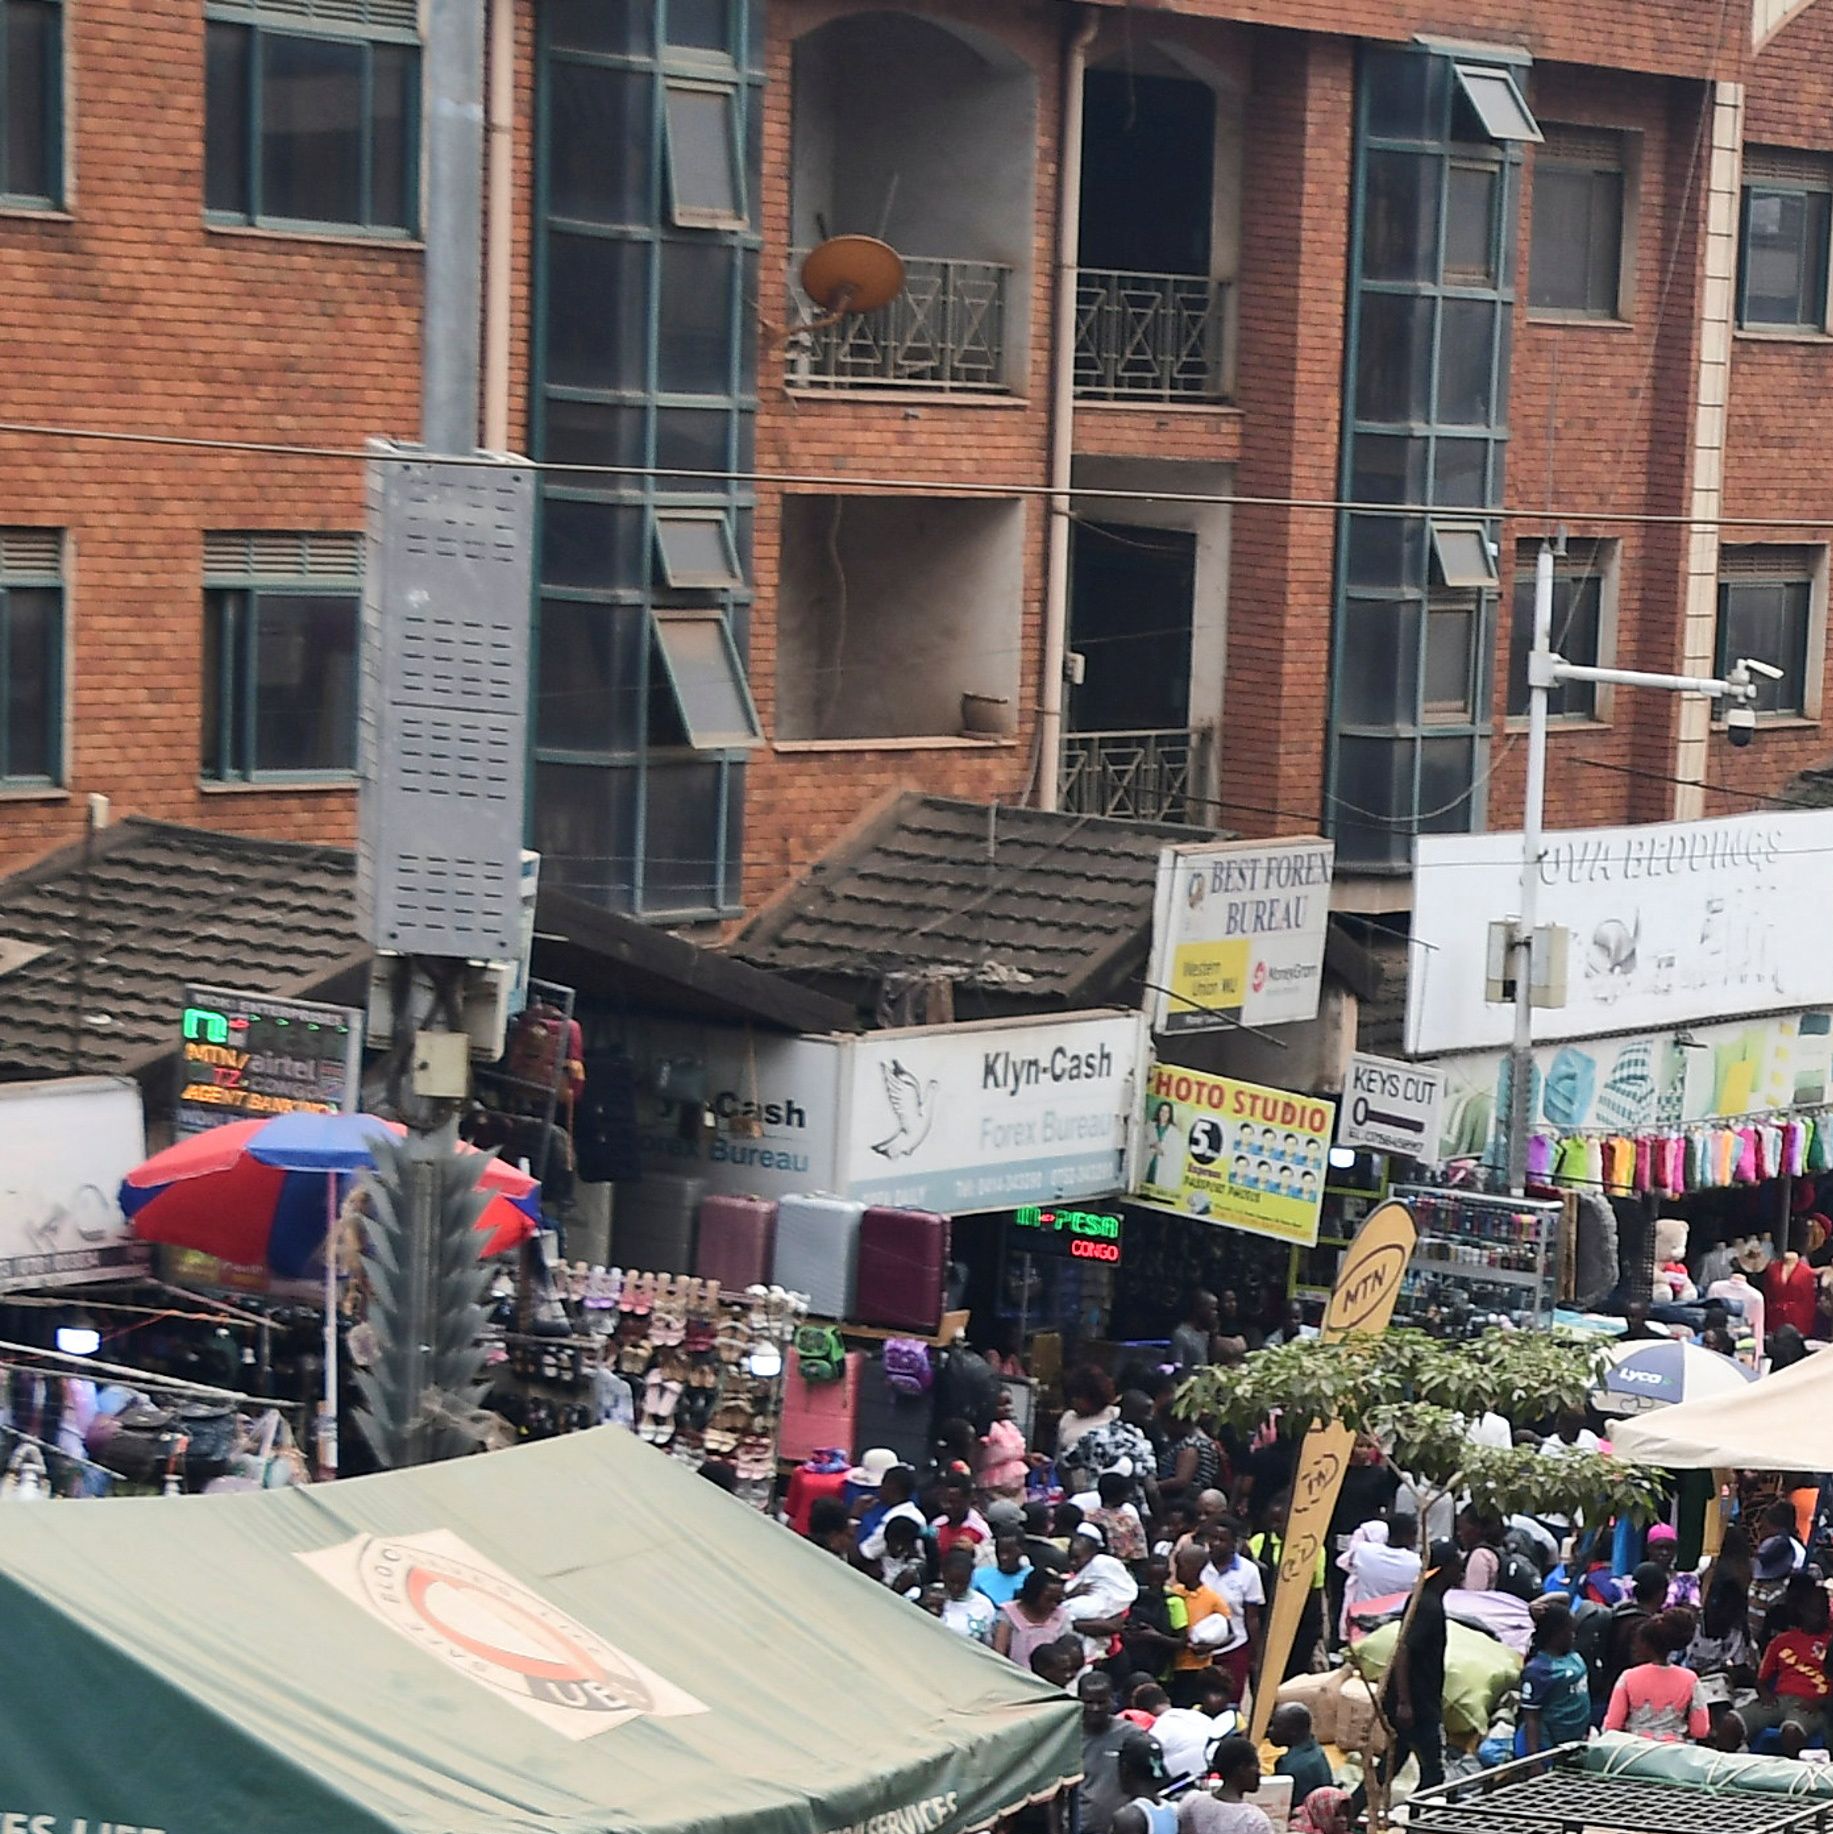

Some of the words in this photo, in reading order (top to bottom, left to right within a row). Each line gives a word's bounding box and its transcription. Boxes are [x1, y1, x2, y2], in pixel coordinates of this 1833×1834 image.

[1210, 857, 1261, 894] BEST
[1265, 852, 1334, 889] FOREX
[1225, 896, 1309, 935] BUREAU
[982, 1042, 1113, 1097] Klyn-Cash
[1353, 1066, 1401, 1099] KEYS
[1403, 1078, 1437, 1105] CUT
[980, 1114, 1038, 1151] Forex
[1043, 1109, 1112, 1144] Bureau
[1232, 1089, 1327, 1133] STUDIO
[708, 1138, 809, 1173] Bureau
[1071, 1239, 1119, 1262] CONGO
[1341, 1262, 1387, 1314] MTN
[1620, 1366, 1662, 1385] Lyca
